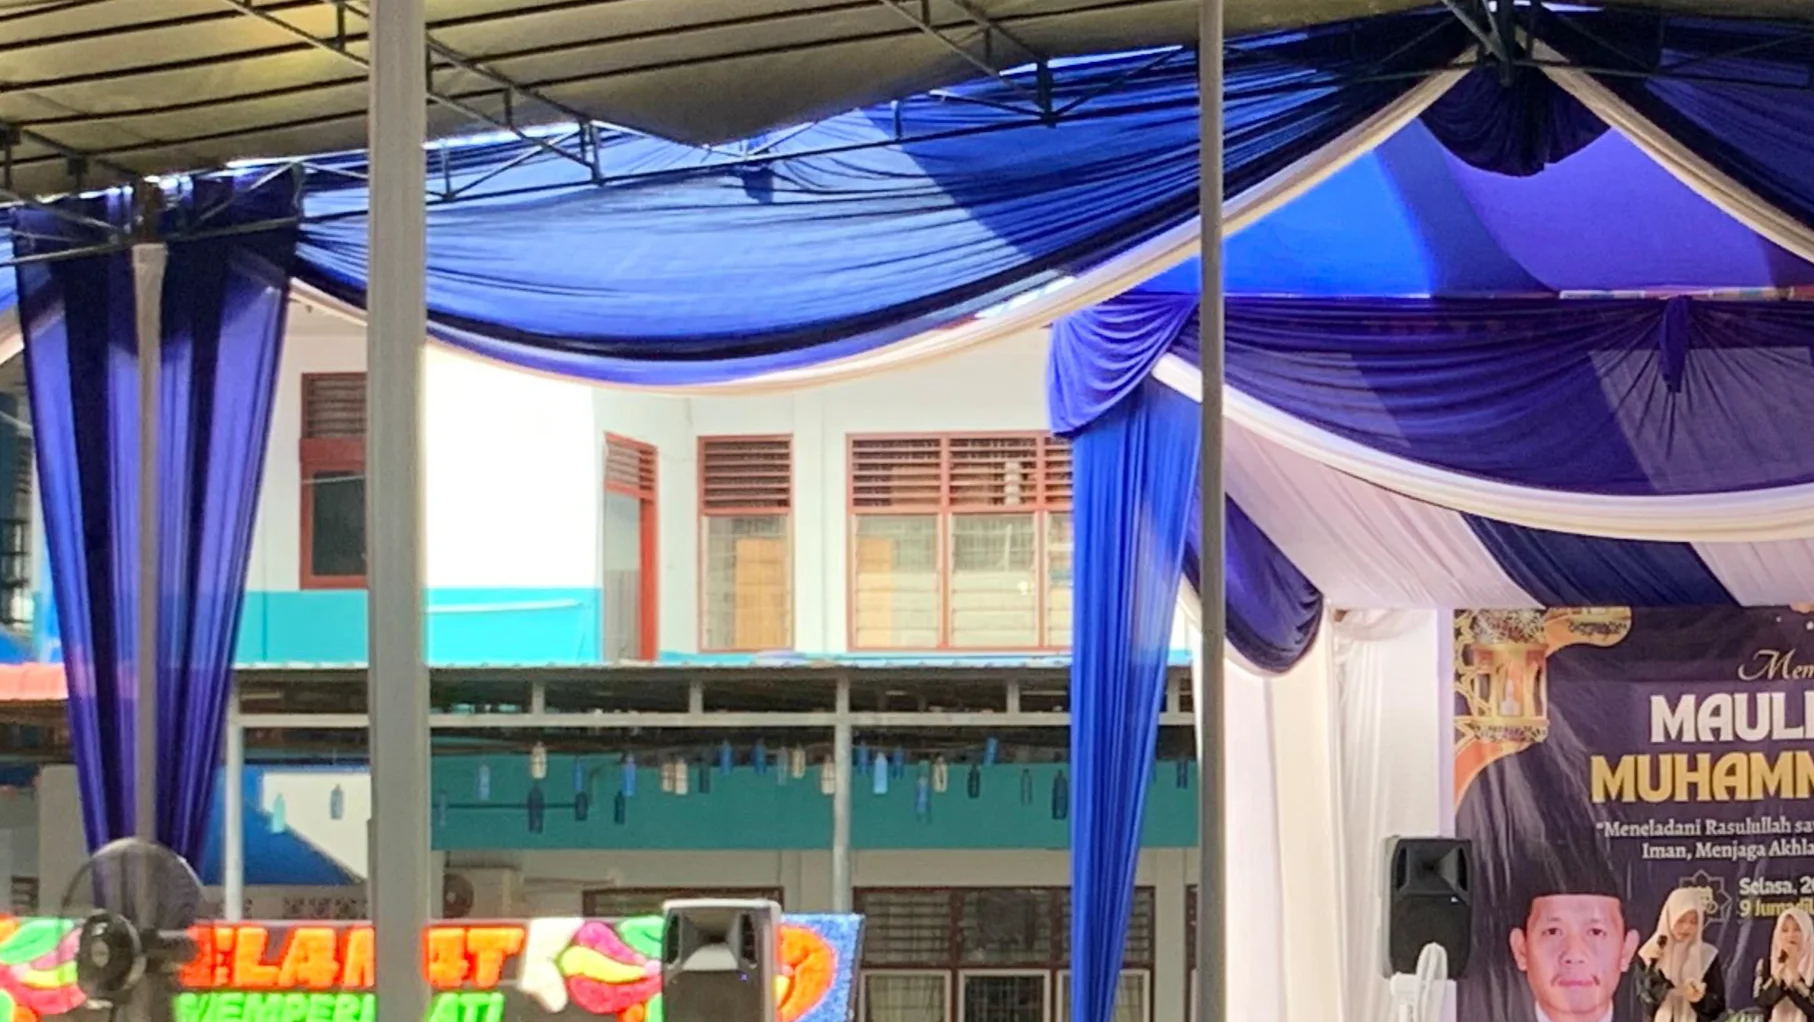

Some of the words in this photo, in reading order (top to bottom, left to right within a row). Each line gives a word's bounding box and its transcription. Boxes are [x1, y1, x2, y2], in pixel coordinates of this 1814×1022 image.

[1705, 816, 1791, 836] Rasulullah
[1642, 842, 1693, 861] Iman,
[1695, 840, 1766, 861] Menjaga
[1739, 899, 1752, 918] 9
